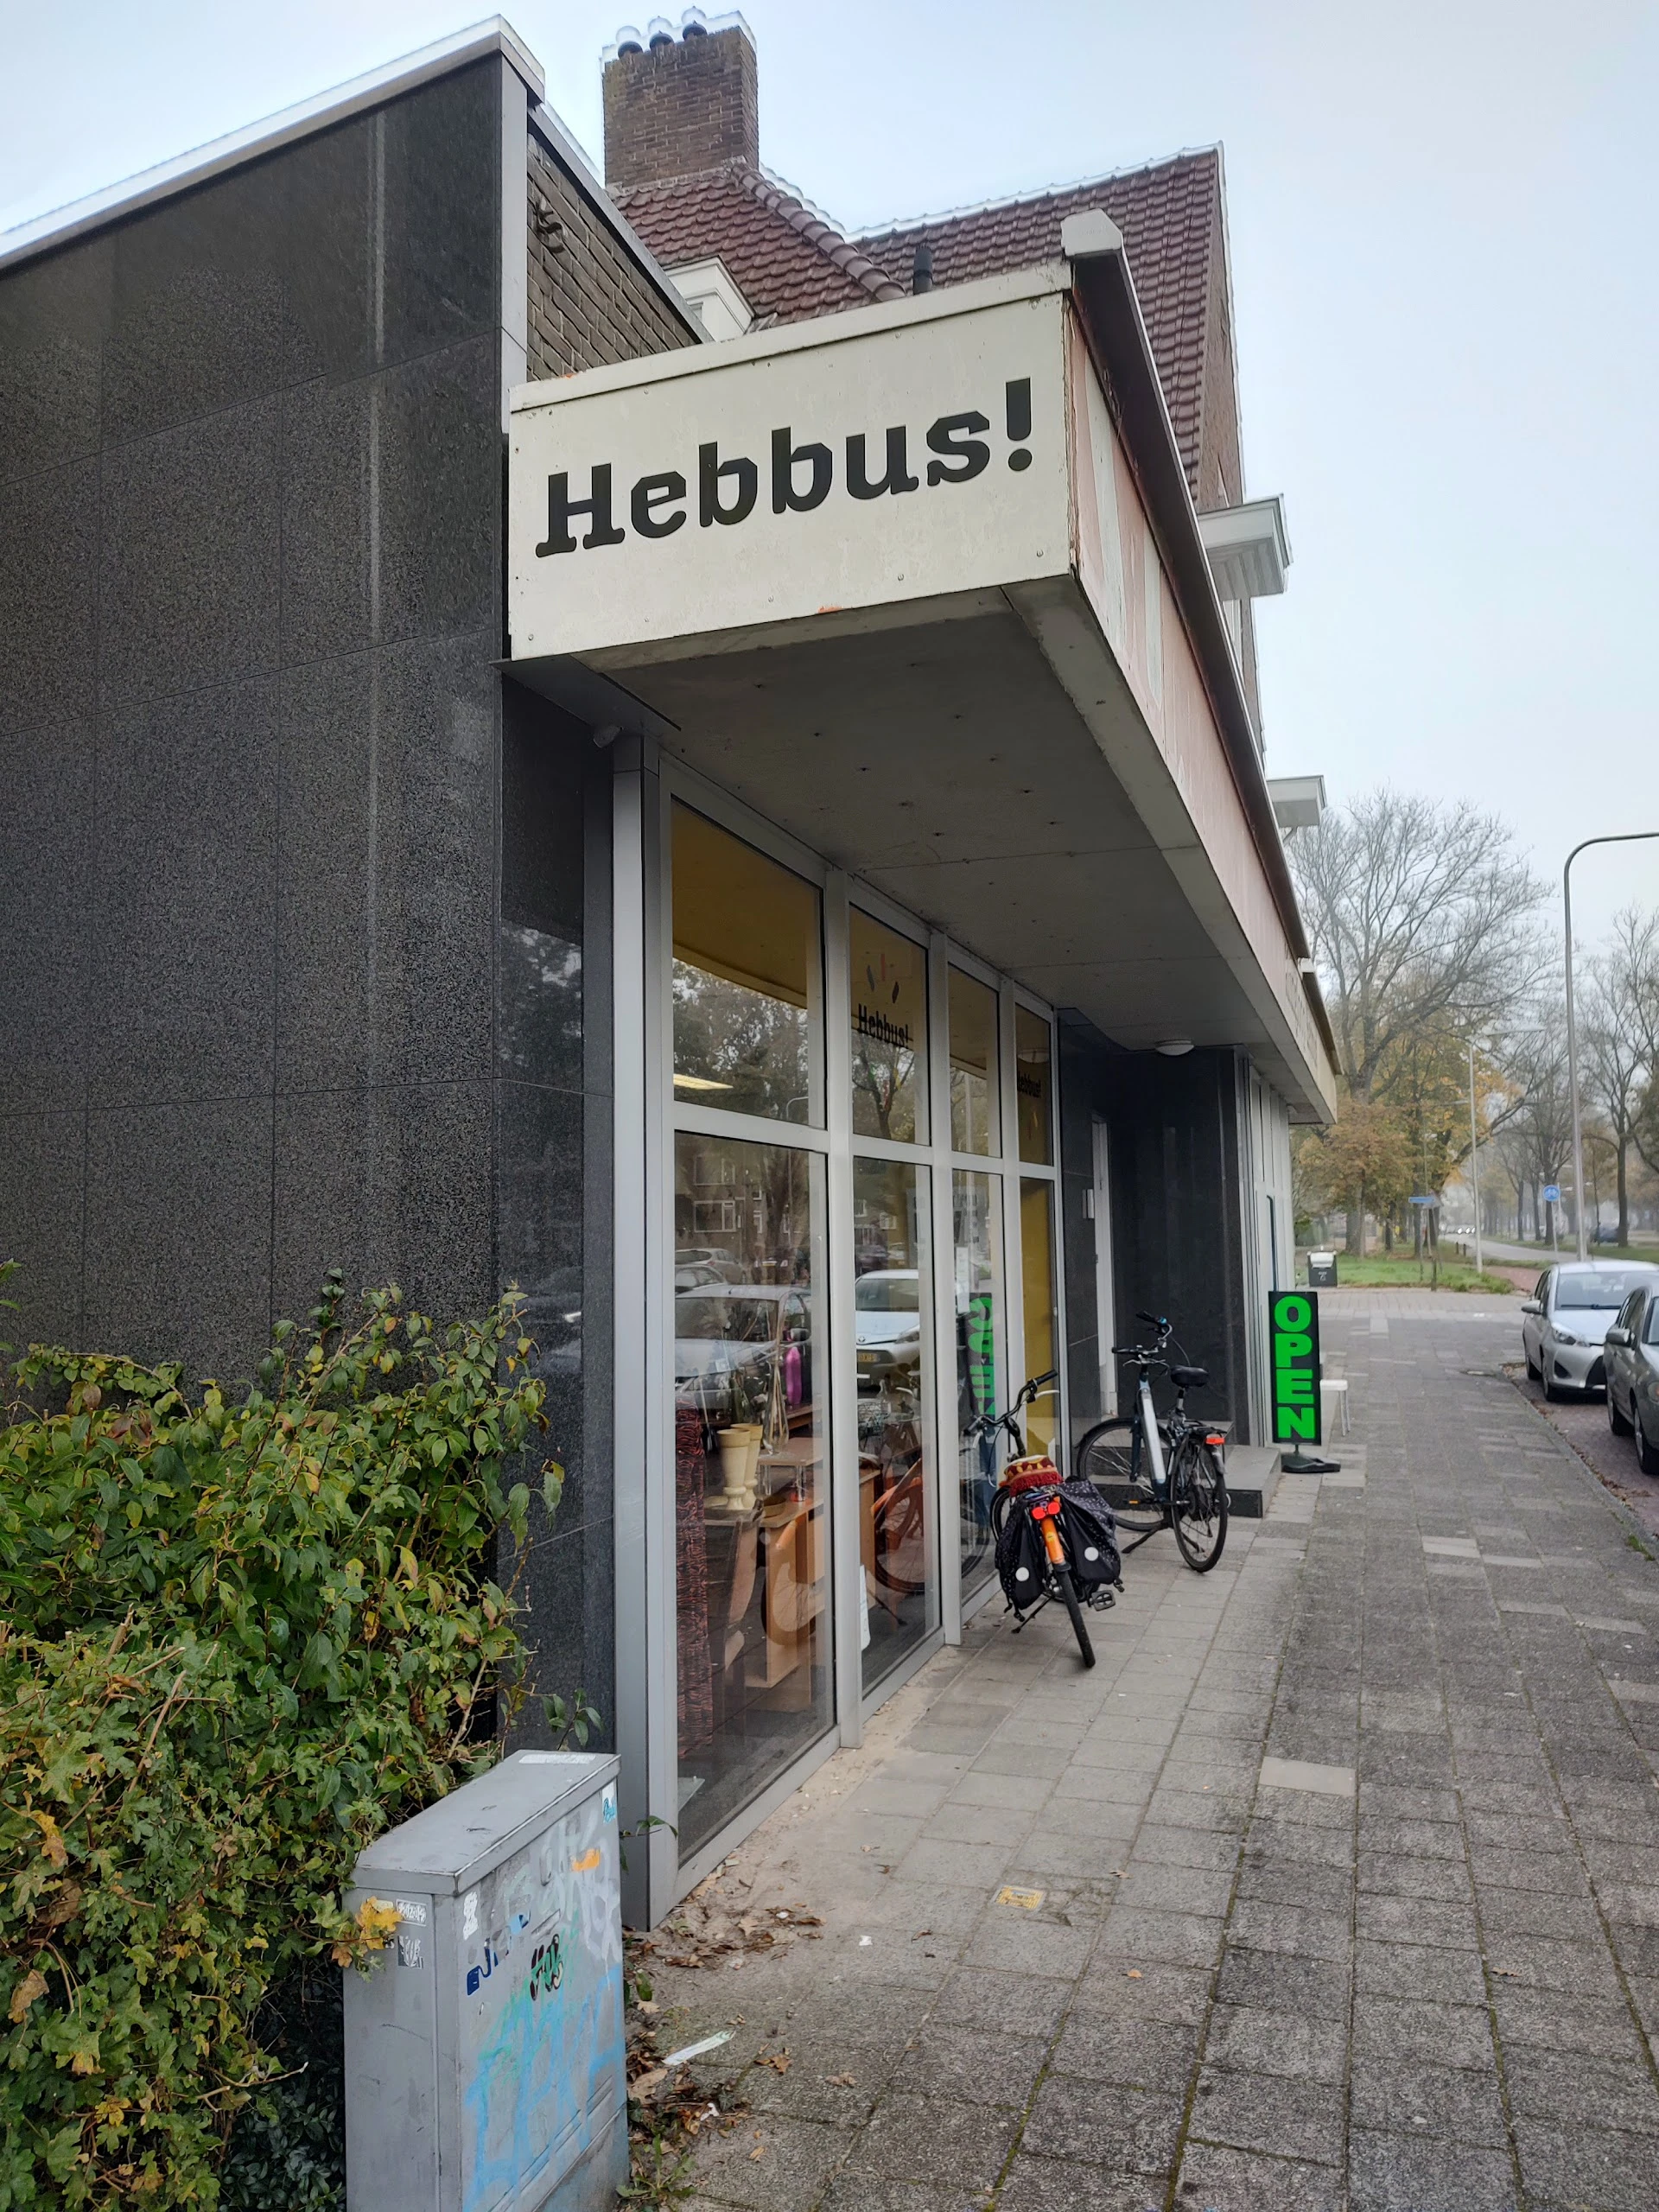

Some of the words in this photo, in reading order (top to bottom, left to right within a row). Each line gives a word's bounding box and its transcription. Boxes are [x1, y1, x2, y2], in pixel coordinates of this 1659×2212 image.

[535, 377, 1033, 558] Hebbus!
[857, 1003, 909, 1050] Hebbus!
[1274, 1296, 1316, 1439] OPEN
